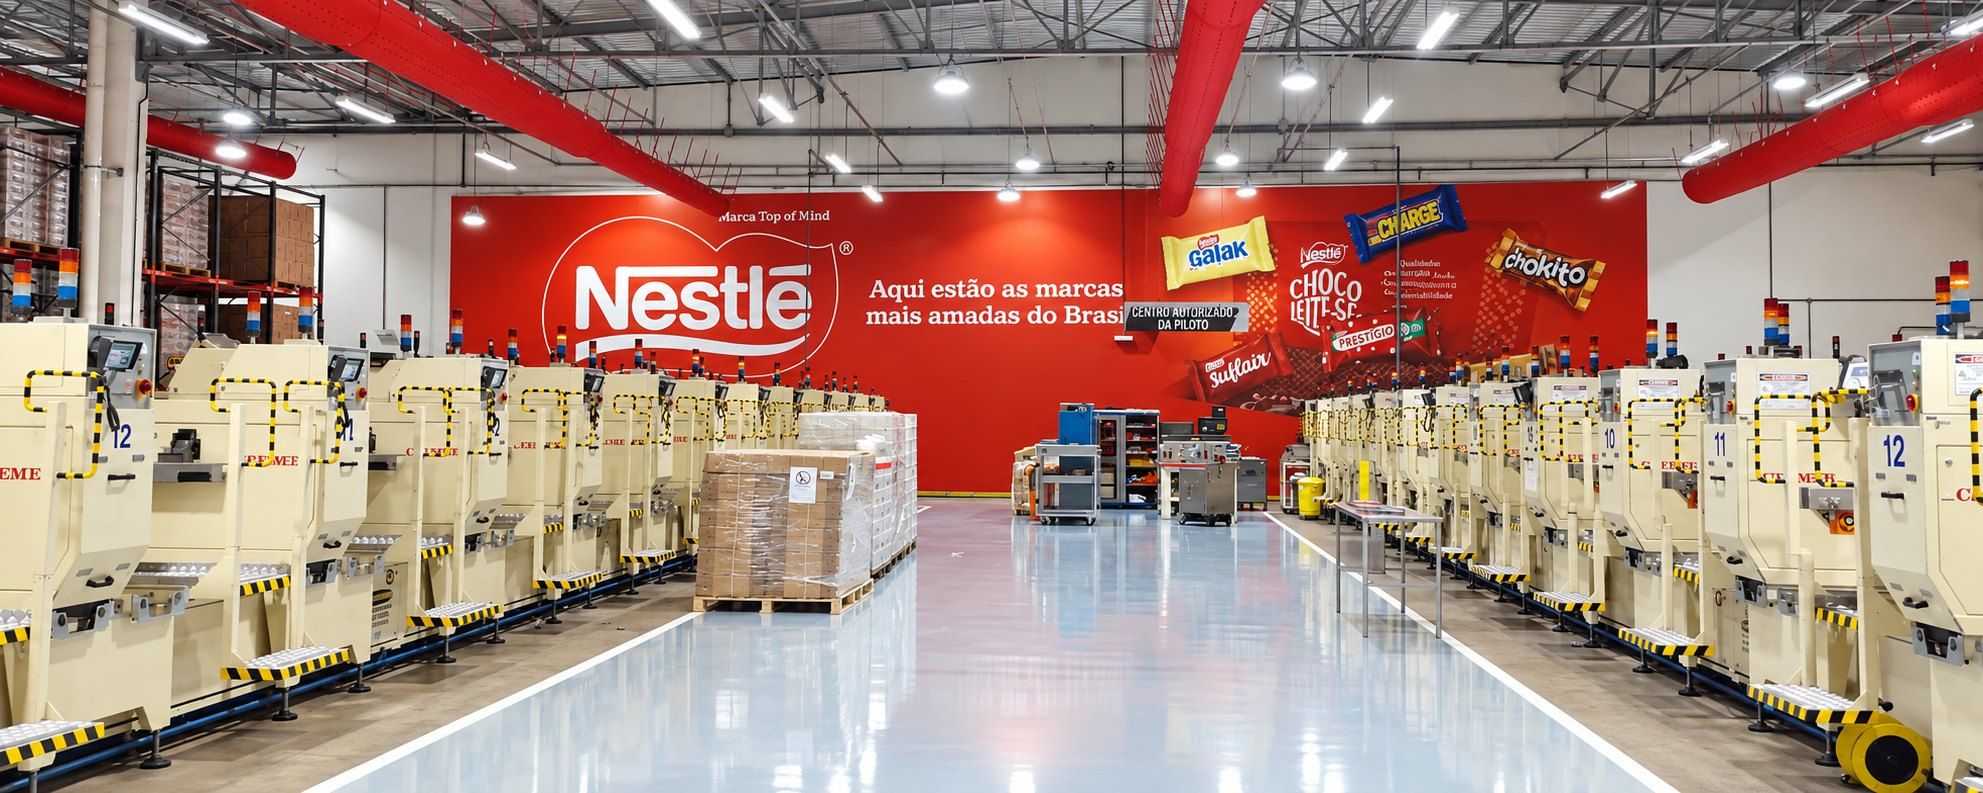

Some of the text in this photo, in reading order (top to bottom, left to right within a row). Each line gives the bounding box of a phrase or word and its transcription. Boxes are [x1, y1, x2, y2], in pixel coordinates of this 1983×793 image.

[718, 210, 830, 224] Marca Top of Mind
[1377, 200, 1441, 239] CHARGE
[1188, 241, 1249, 268] Galak
[1300, 246, 1342, 263] Nestlé
[1504, 247, 1586, 287] chokito
[575, 264, 813, 331] Nestlé
[869, 278, 1124, 303] Aqui estão as marcas
[1289, 267, 1363, 302] CHOCO
[866, 305, 1124, 324] mais amadas do Brasi
[1132, 306, 1233, 318] CENTRO AUTORIZADO
[1158, 318, 1209, 331] DA PILOTO
[112, 423, 132, 449] 12
[1604, 428, 1615, 449] 10
[1715, 431, 1726, 457] 11
[1883, 434, 1906, 468] 12
